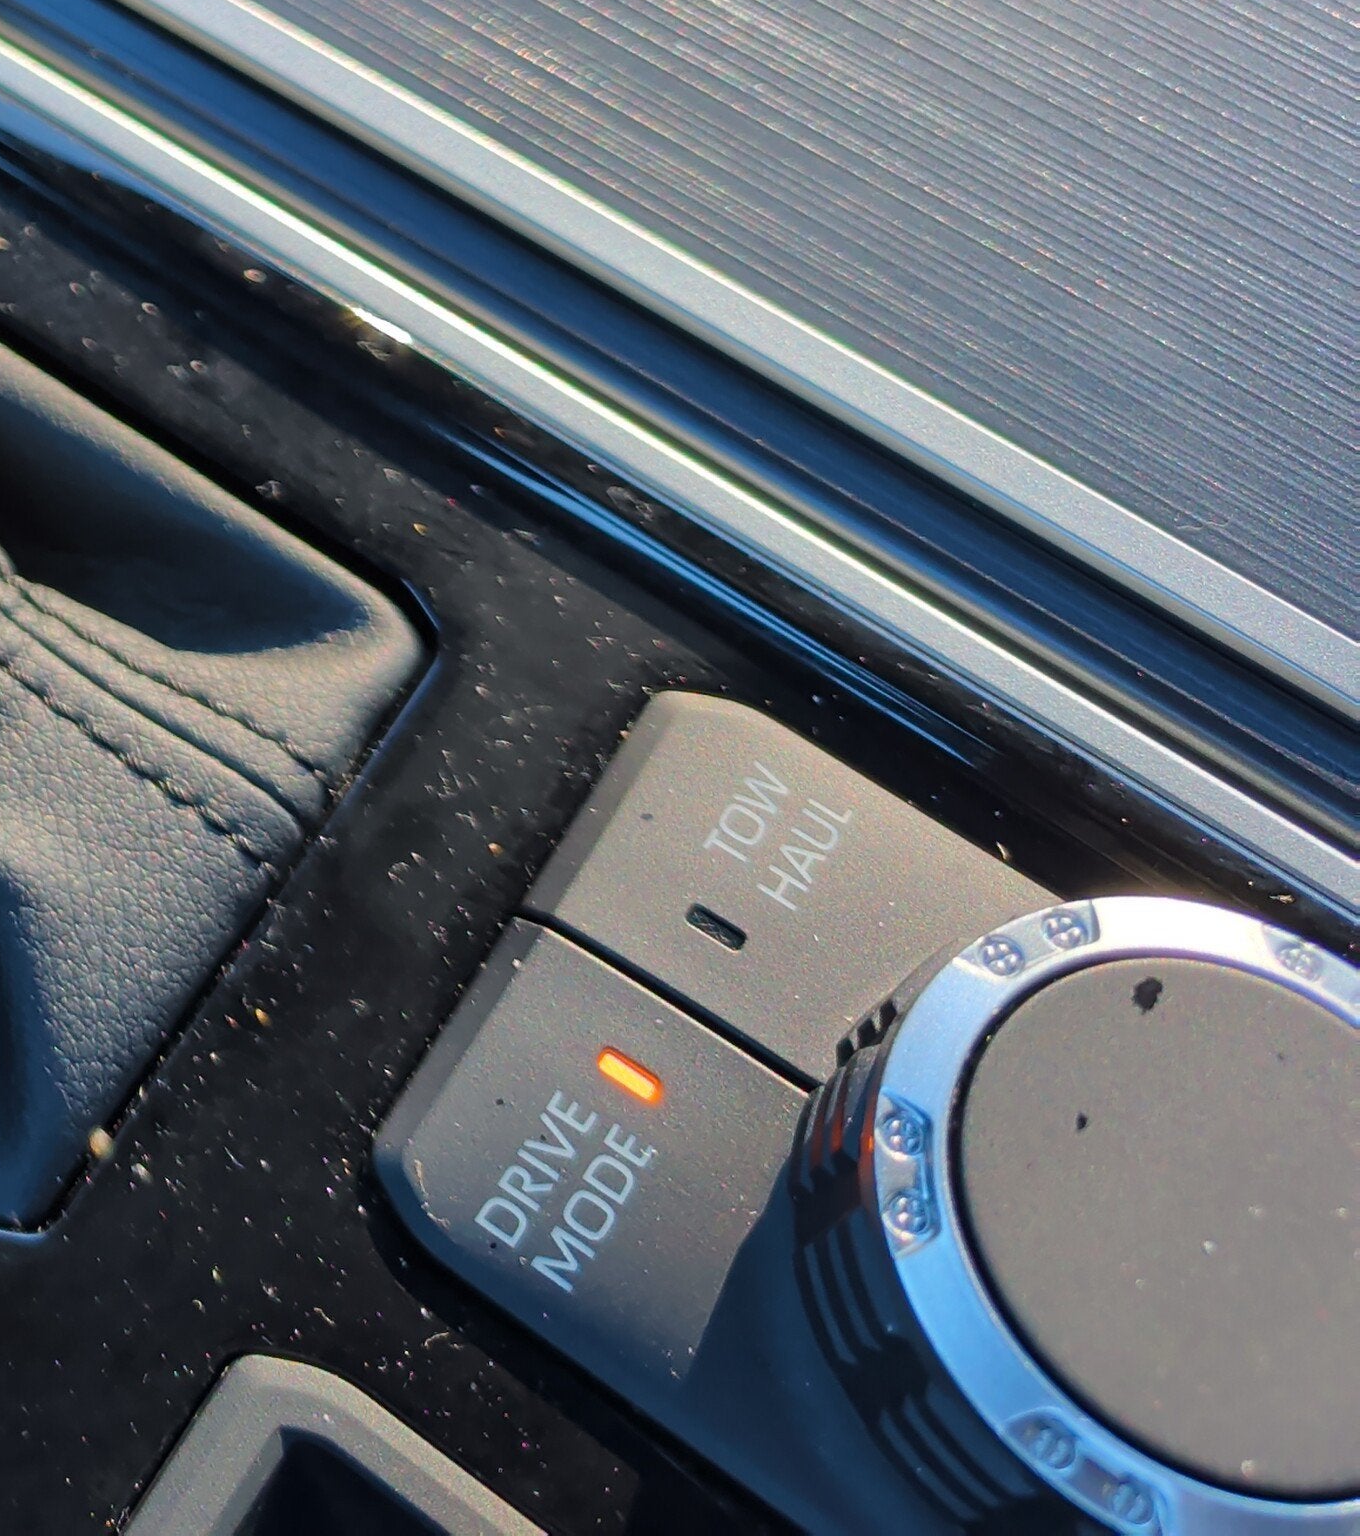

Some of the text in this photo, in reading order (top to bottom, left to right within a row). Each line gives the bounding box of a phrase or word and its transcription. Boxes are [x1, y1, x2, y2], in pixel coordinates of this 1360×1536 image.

[701, 760, 792, 866] TOW
[756, 799, 854, 912] HAUL
[473, 1089, 598, 1251] DRIVE
[530, 1125, 654, 1294] MODE
